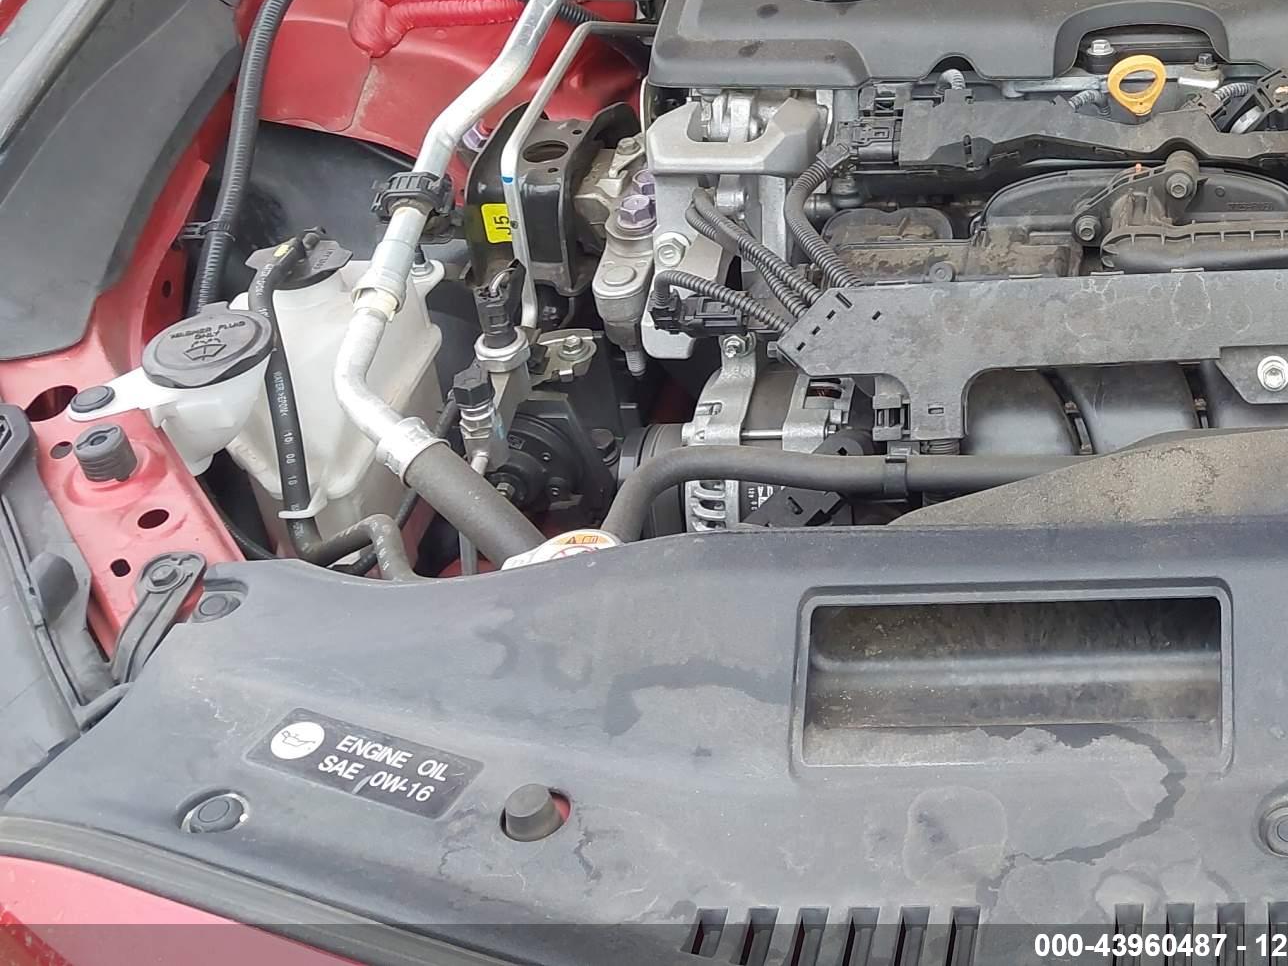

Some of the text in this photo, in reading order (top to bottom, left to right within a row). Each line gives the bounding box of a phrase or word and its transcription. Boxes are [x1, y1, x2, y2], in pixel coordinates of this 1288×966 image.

[318, 755, 435, 802] SAE 0W-16
[336, 735, 449, 782] ENGINE OIL
